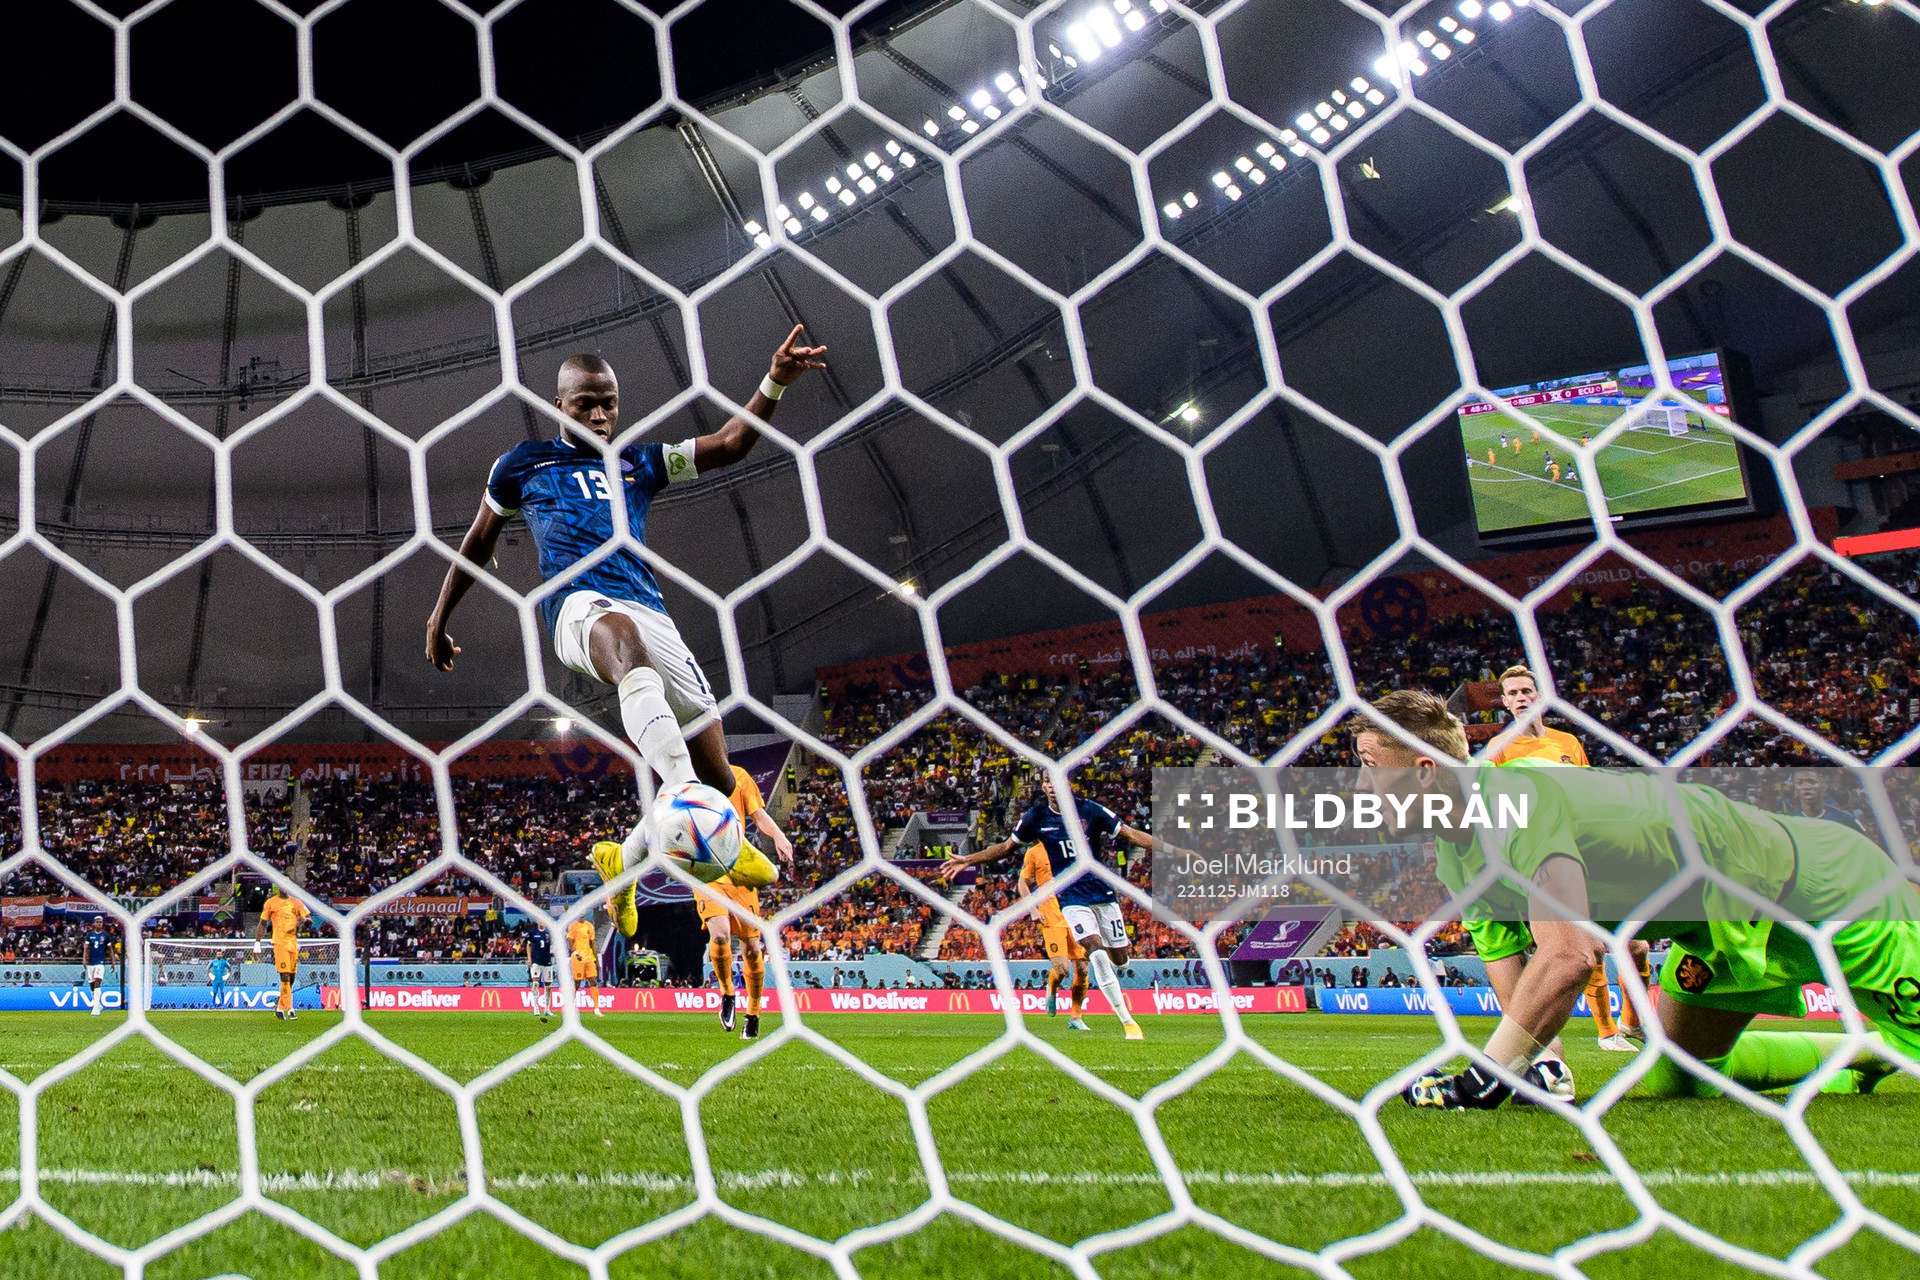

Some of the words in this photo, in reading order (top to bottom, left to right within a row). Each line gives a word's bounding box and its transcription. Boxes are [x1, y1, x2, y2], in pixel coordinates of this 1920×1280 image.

[1518, 397, 1535, 405] NED
[1578, 388, 1595, 397] ECU
[572, 469, 614, 500] 13
[247, 763, 292, 780] FIFA
[1058, 839, 1078, 859] 19
[375, 898, 462, 914] adskanaal
[1110, 918, 1125, 939] 19
[48, 986, 122, 1008] vivo
[210, 987, 281, 1008] vivo
[369, 990, 396, 1007] We
[397, 989, 461, 1008] Deliver
[552, 990, 615, 1008] Dliver
[674, 992, 704, 1009] We
[705, 990, 770, 1009] Divr
[830, 992, 860, 1010] We
[862, 991, 929, 1010] Deliver
[1022, 993, 1090, 1011] Deivr
[1152, 992, 1184, 1010] We
[1186, 992, 1255, 1010] Deler
[1335, 988, 1369, 1011] vivo
[1476, 987, 1502, 1011] vi
[1805, 987, 1838, 1012] Deli
